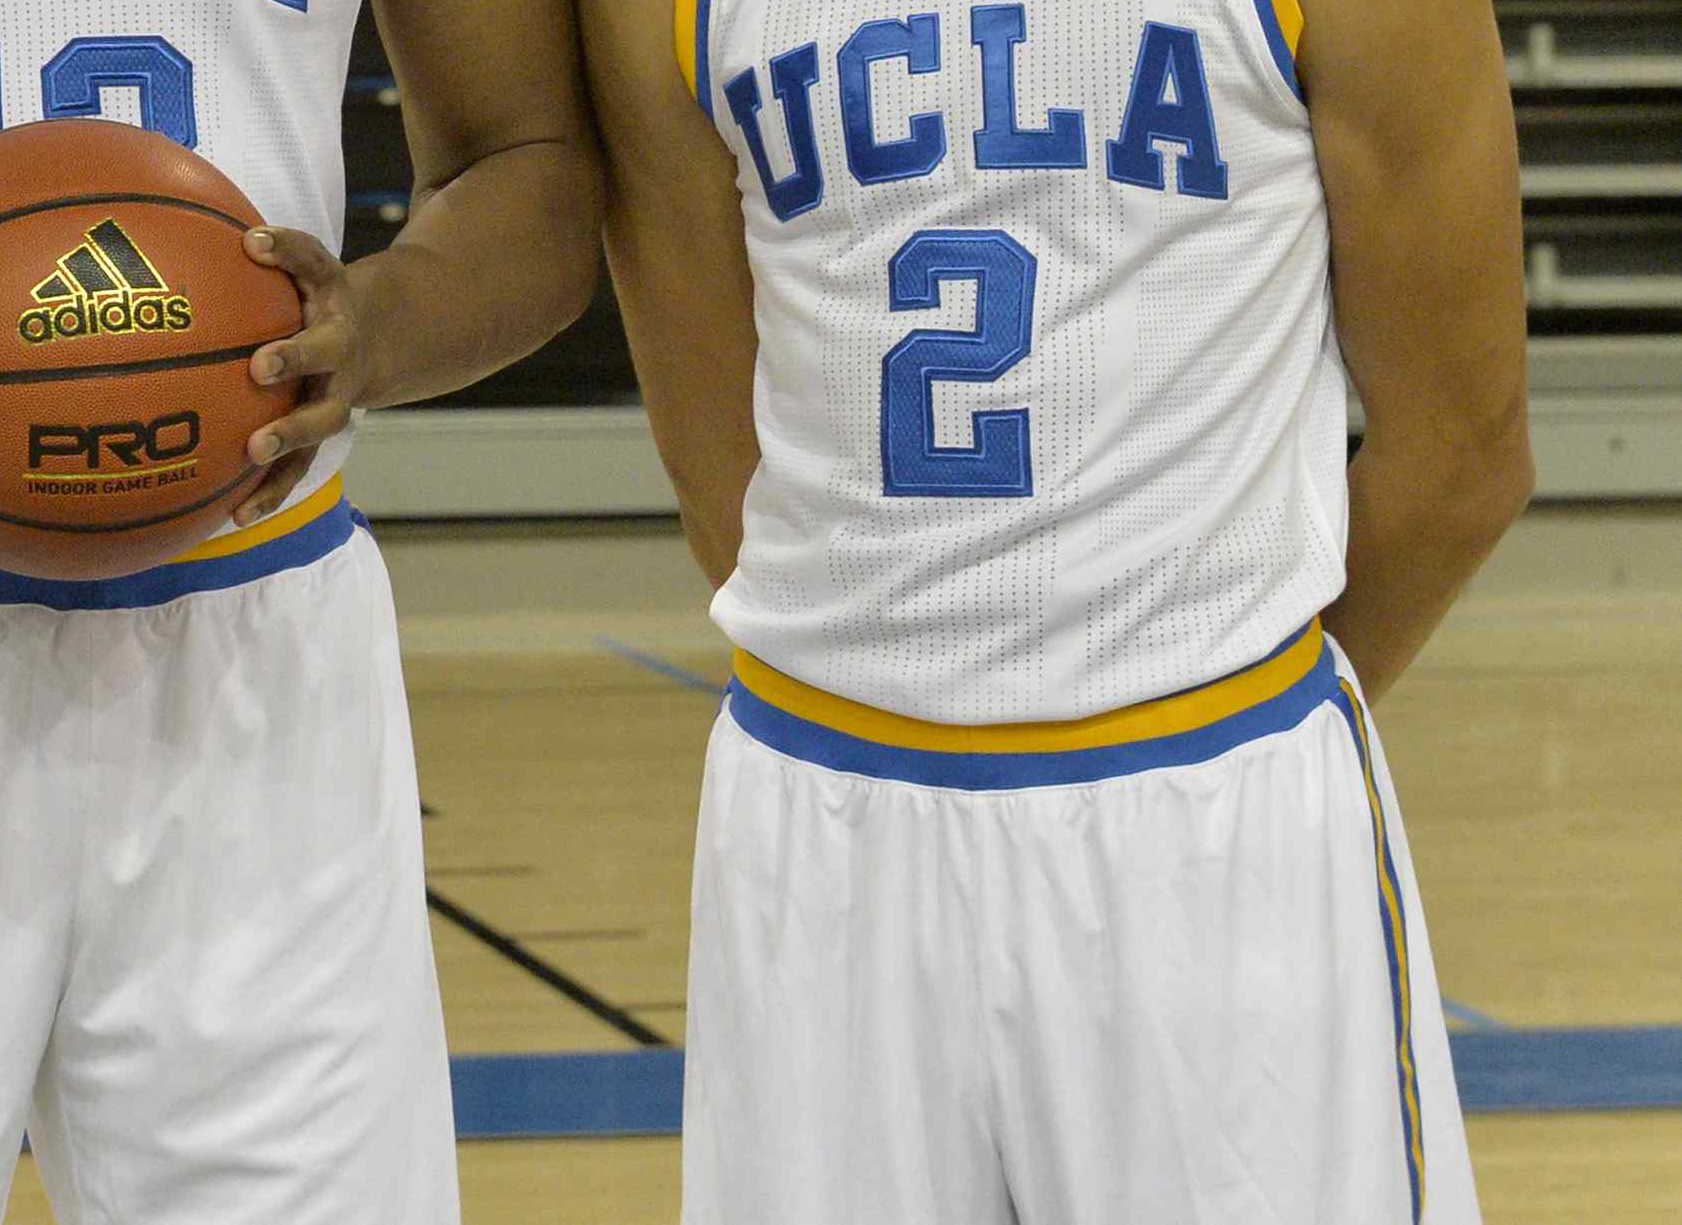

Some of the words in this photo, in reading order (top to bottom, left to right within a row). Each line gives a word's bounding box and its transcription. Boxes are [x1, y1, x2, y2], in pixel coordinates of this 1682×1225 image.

[723, 3, 1228, 223] UCLA
[18, 289, 192, 345] adidas
[882, 229, 1038, 498] 2
[29, 410, 200, 469] PRO
[28, 480, 97, 495] INDOOR
[102, 475, 152, 494] GAME
[157, 466, 199, 487] BALL
